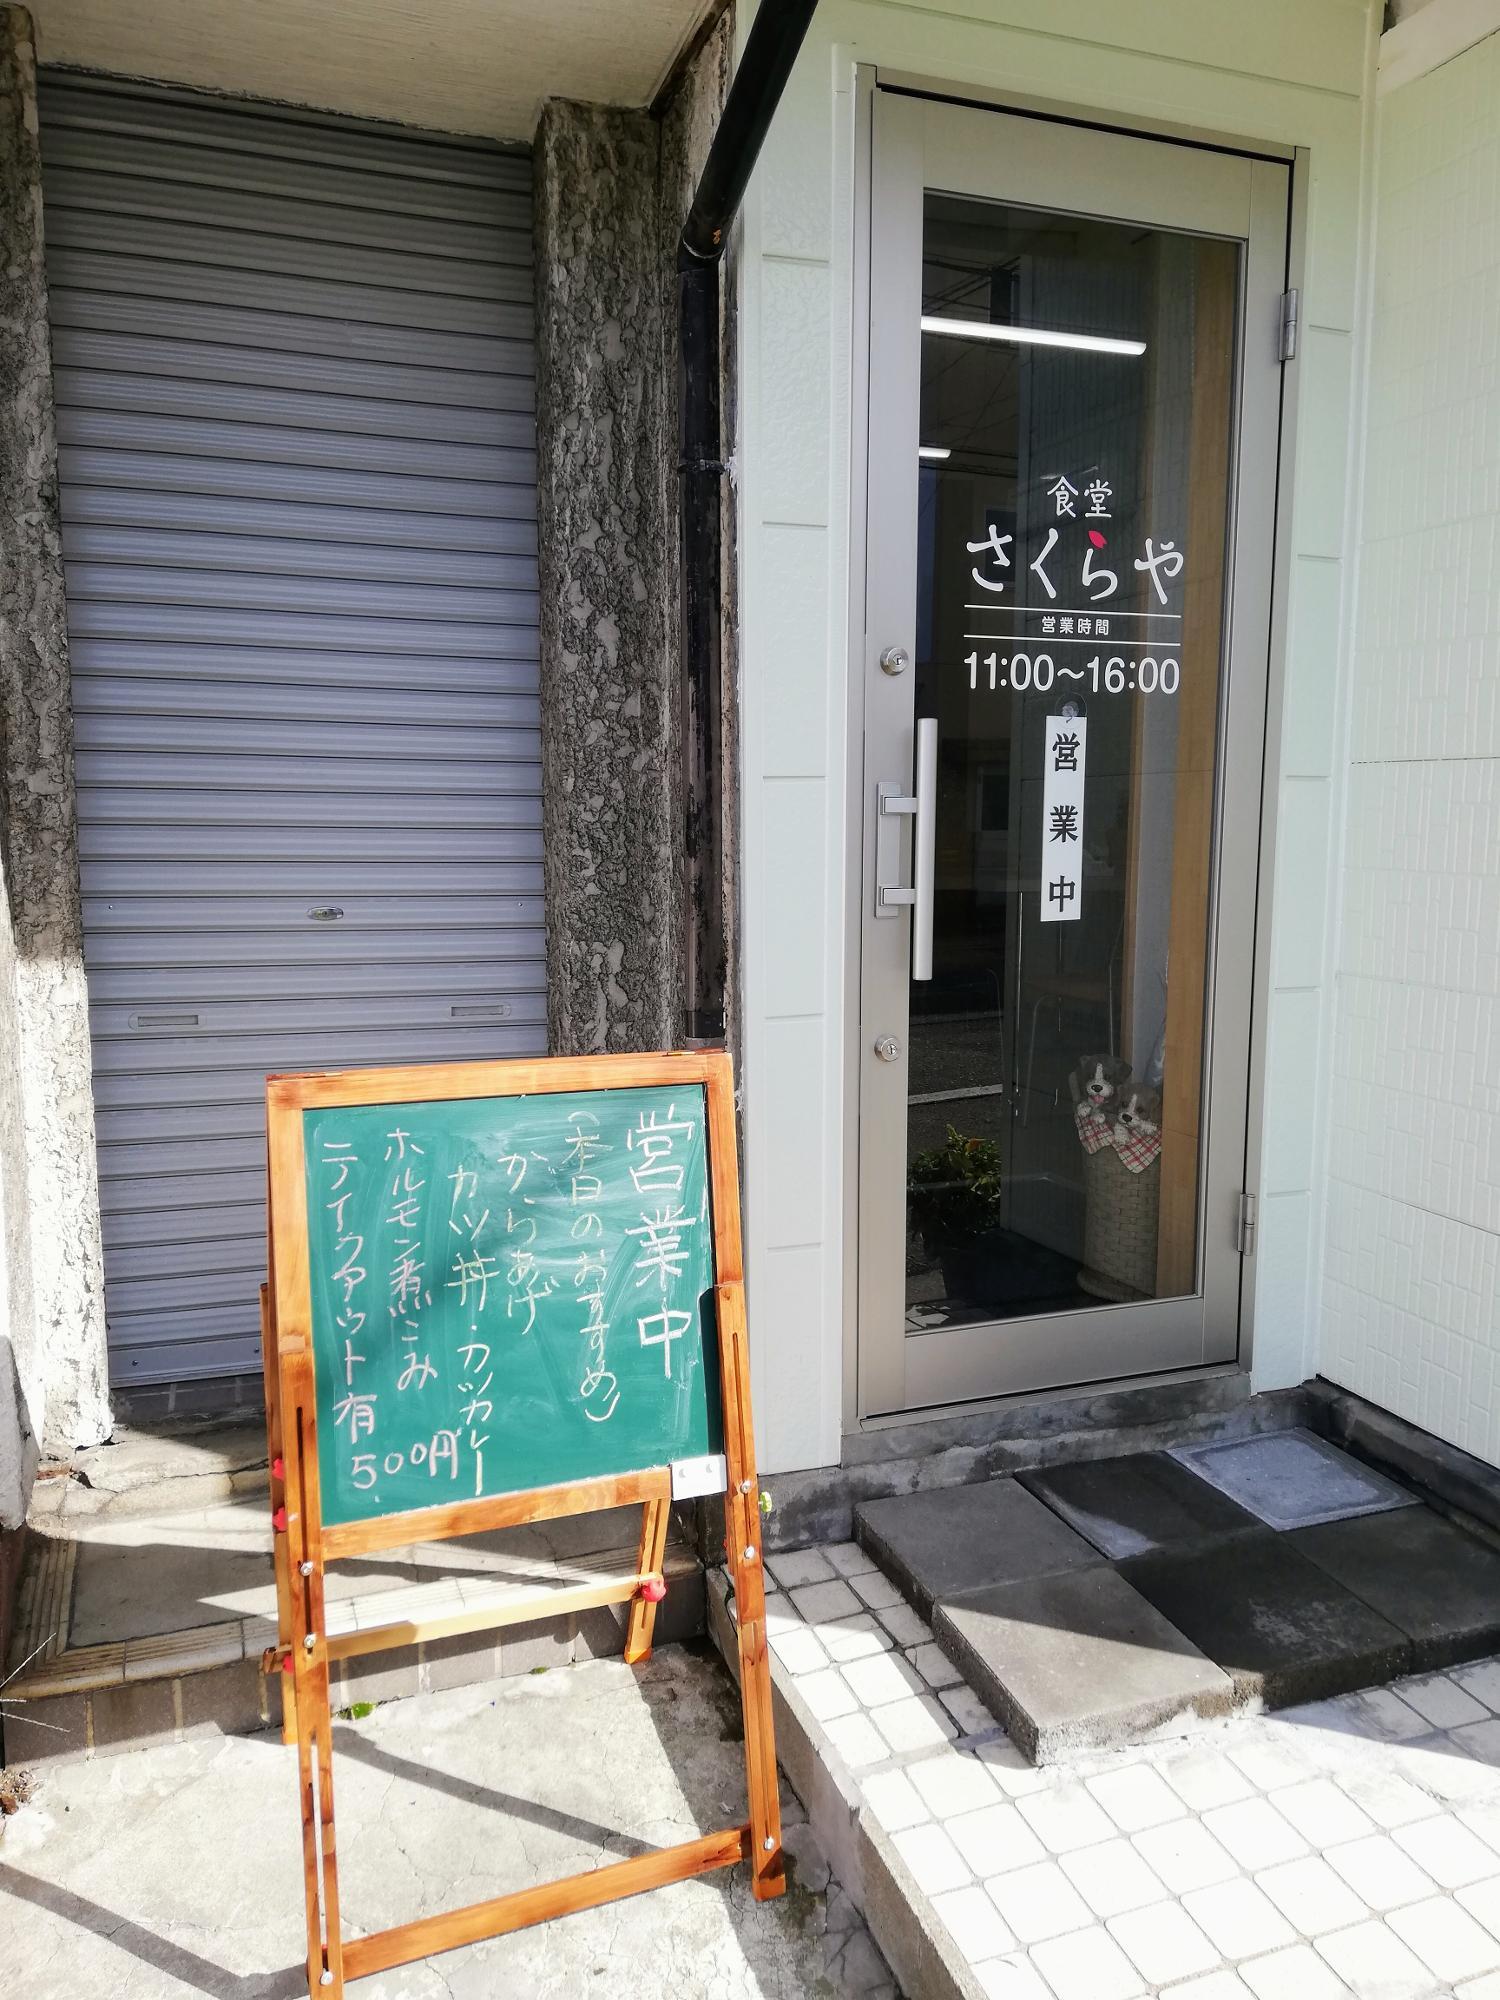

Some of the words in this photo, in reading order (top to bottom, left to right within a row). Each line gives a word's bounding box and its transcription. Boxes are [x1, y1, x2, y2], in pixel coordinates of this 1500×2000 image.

[965, 523, 1185, 605] さくらや
[1046, 475, 1114, 519] 食堂
[1041, 615, 1110, 636] 営業時間
[1048, 732, 1081, 914] 営業中
[321, 1143, 378, 1444] テイクアウト有
[384, 1127, 438, 1391] ホルモン煮こみ
[497, 1150, 560, 1335] からあげ
[624, 1103, 698, 1380] 営業中
